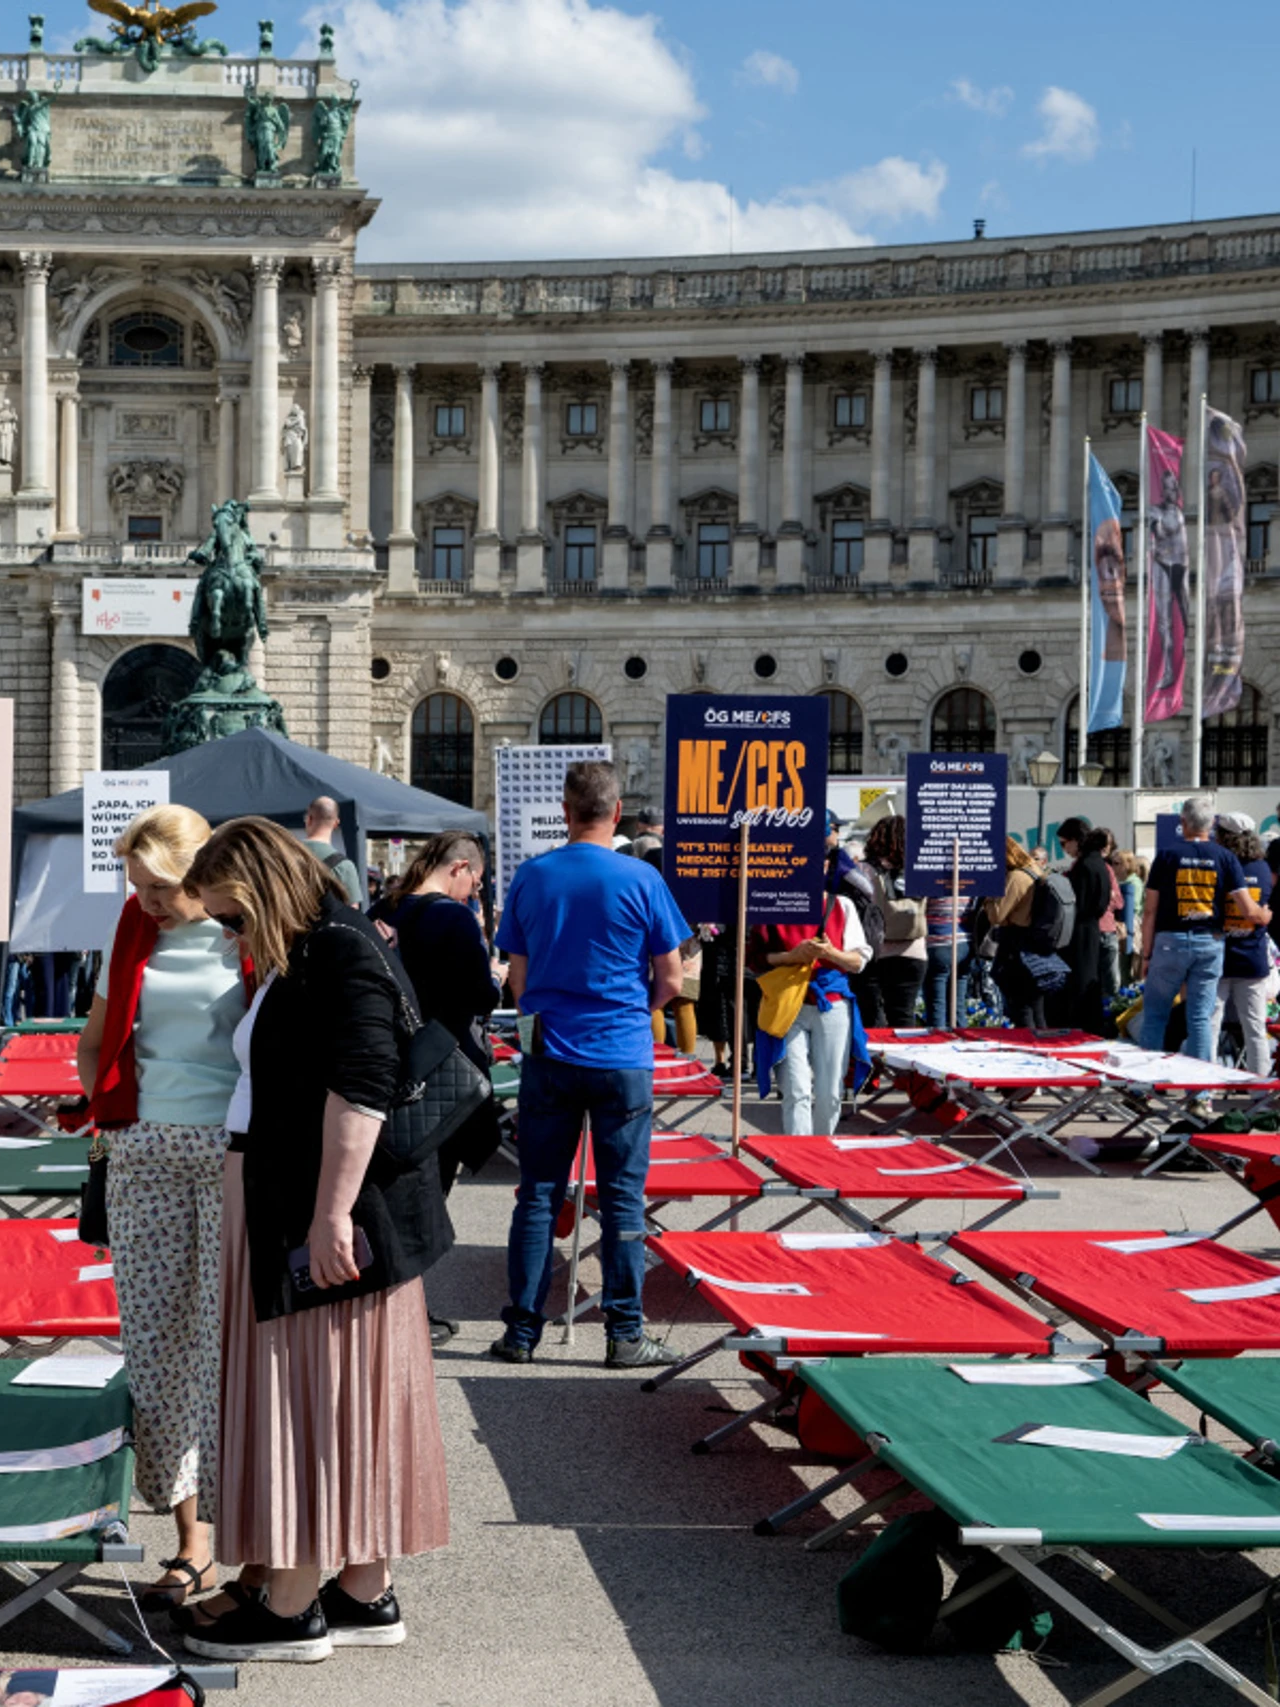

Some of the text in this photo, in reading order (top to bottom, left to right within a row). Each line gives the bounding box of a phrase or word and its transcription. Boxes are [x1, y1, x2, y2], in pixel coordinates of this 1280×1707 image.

[704, 707, 791, 725] ÖG ME/CFS
[677, 739, 806, 814] ME/CFS
[765, 806, 814, 828] 1969
[708, 842, 730, 852] THE
[677, 855, 808, 866] MEDICAL SANDAL OF
[677, 868, 699, 878] THE
